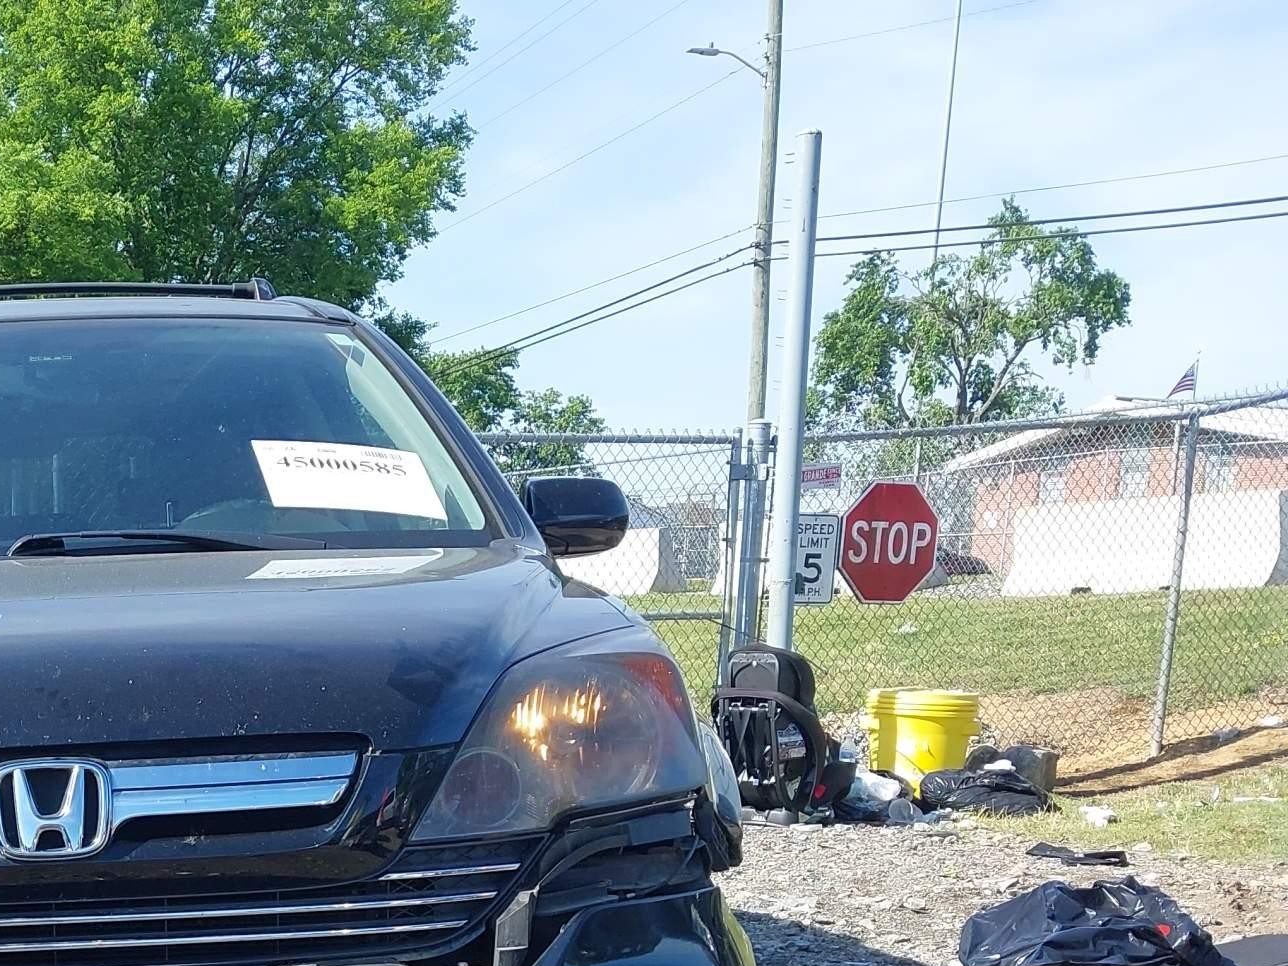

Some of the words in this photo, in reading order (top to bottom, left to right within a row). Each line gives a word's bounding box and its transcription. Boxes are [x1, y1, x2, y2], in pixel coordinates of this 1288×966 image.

[276, 456, 408, 478] 45000585
[798, 523, 835, 535] SPEED
[799, 536, 830, 549] LIMIT
[847, 520, 932, 566] STOP
[802, 552, 822, 584] 5
